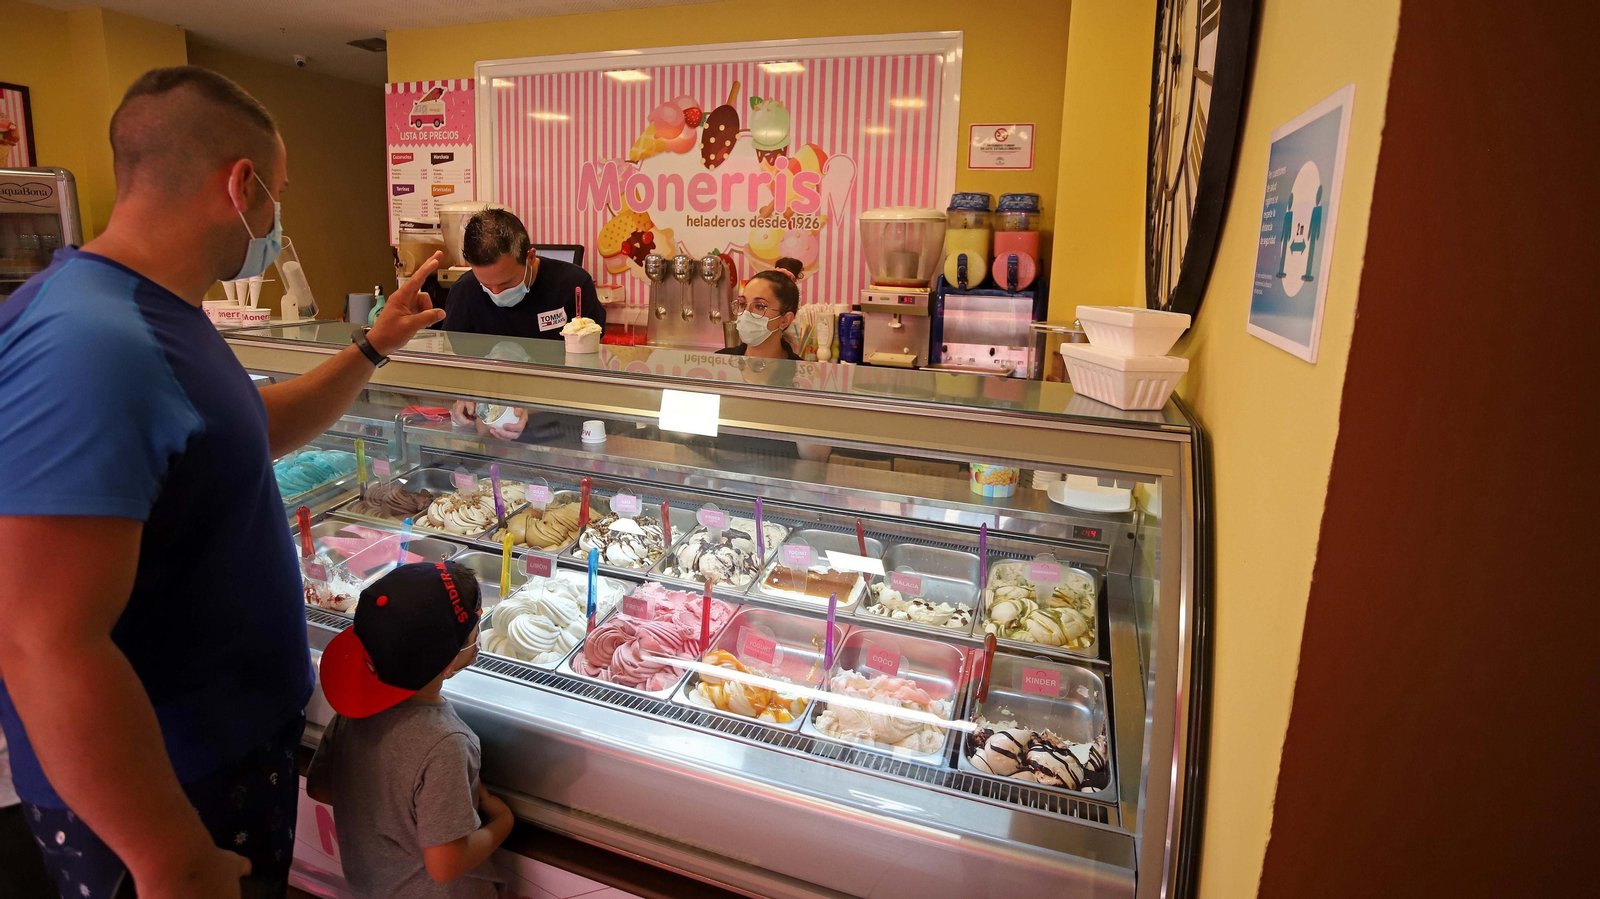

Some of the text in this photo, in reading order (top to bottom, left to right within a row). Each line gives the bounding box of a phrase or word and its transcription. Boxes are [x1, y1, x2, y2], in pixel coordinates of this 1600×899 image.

[400, 130, 459, 140] LISTA DE PRECIOS
[576, 156, 822, 213] Monerris
[686, 215, 820, 230] heladeros desde 1926
[1296, 222, 1301, 236] 2
[625, 602, 645, 613] FRESA
[749, 640, 773, 652] YOGURT
[872, 654, 893, 667] COCO
[1025, 676, 1057, 687] KINDER
